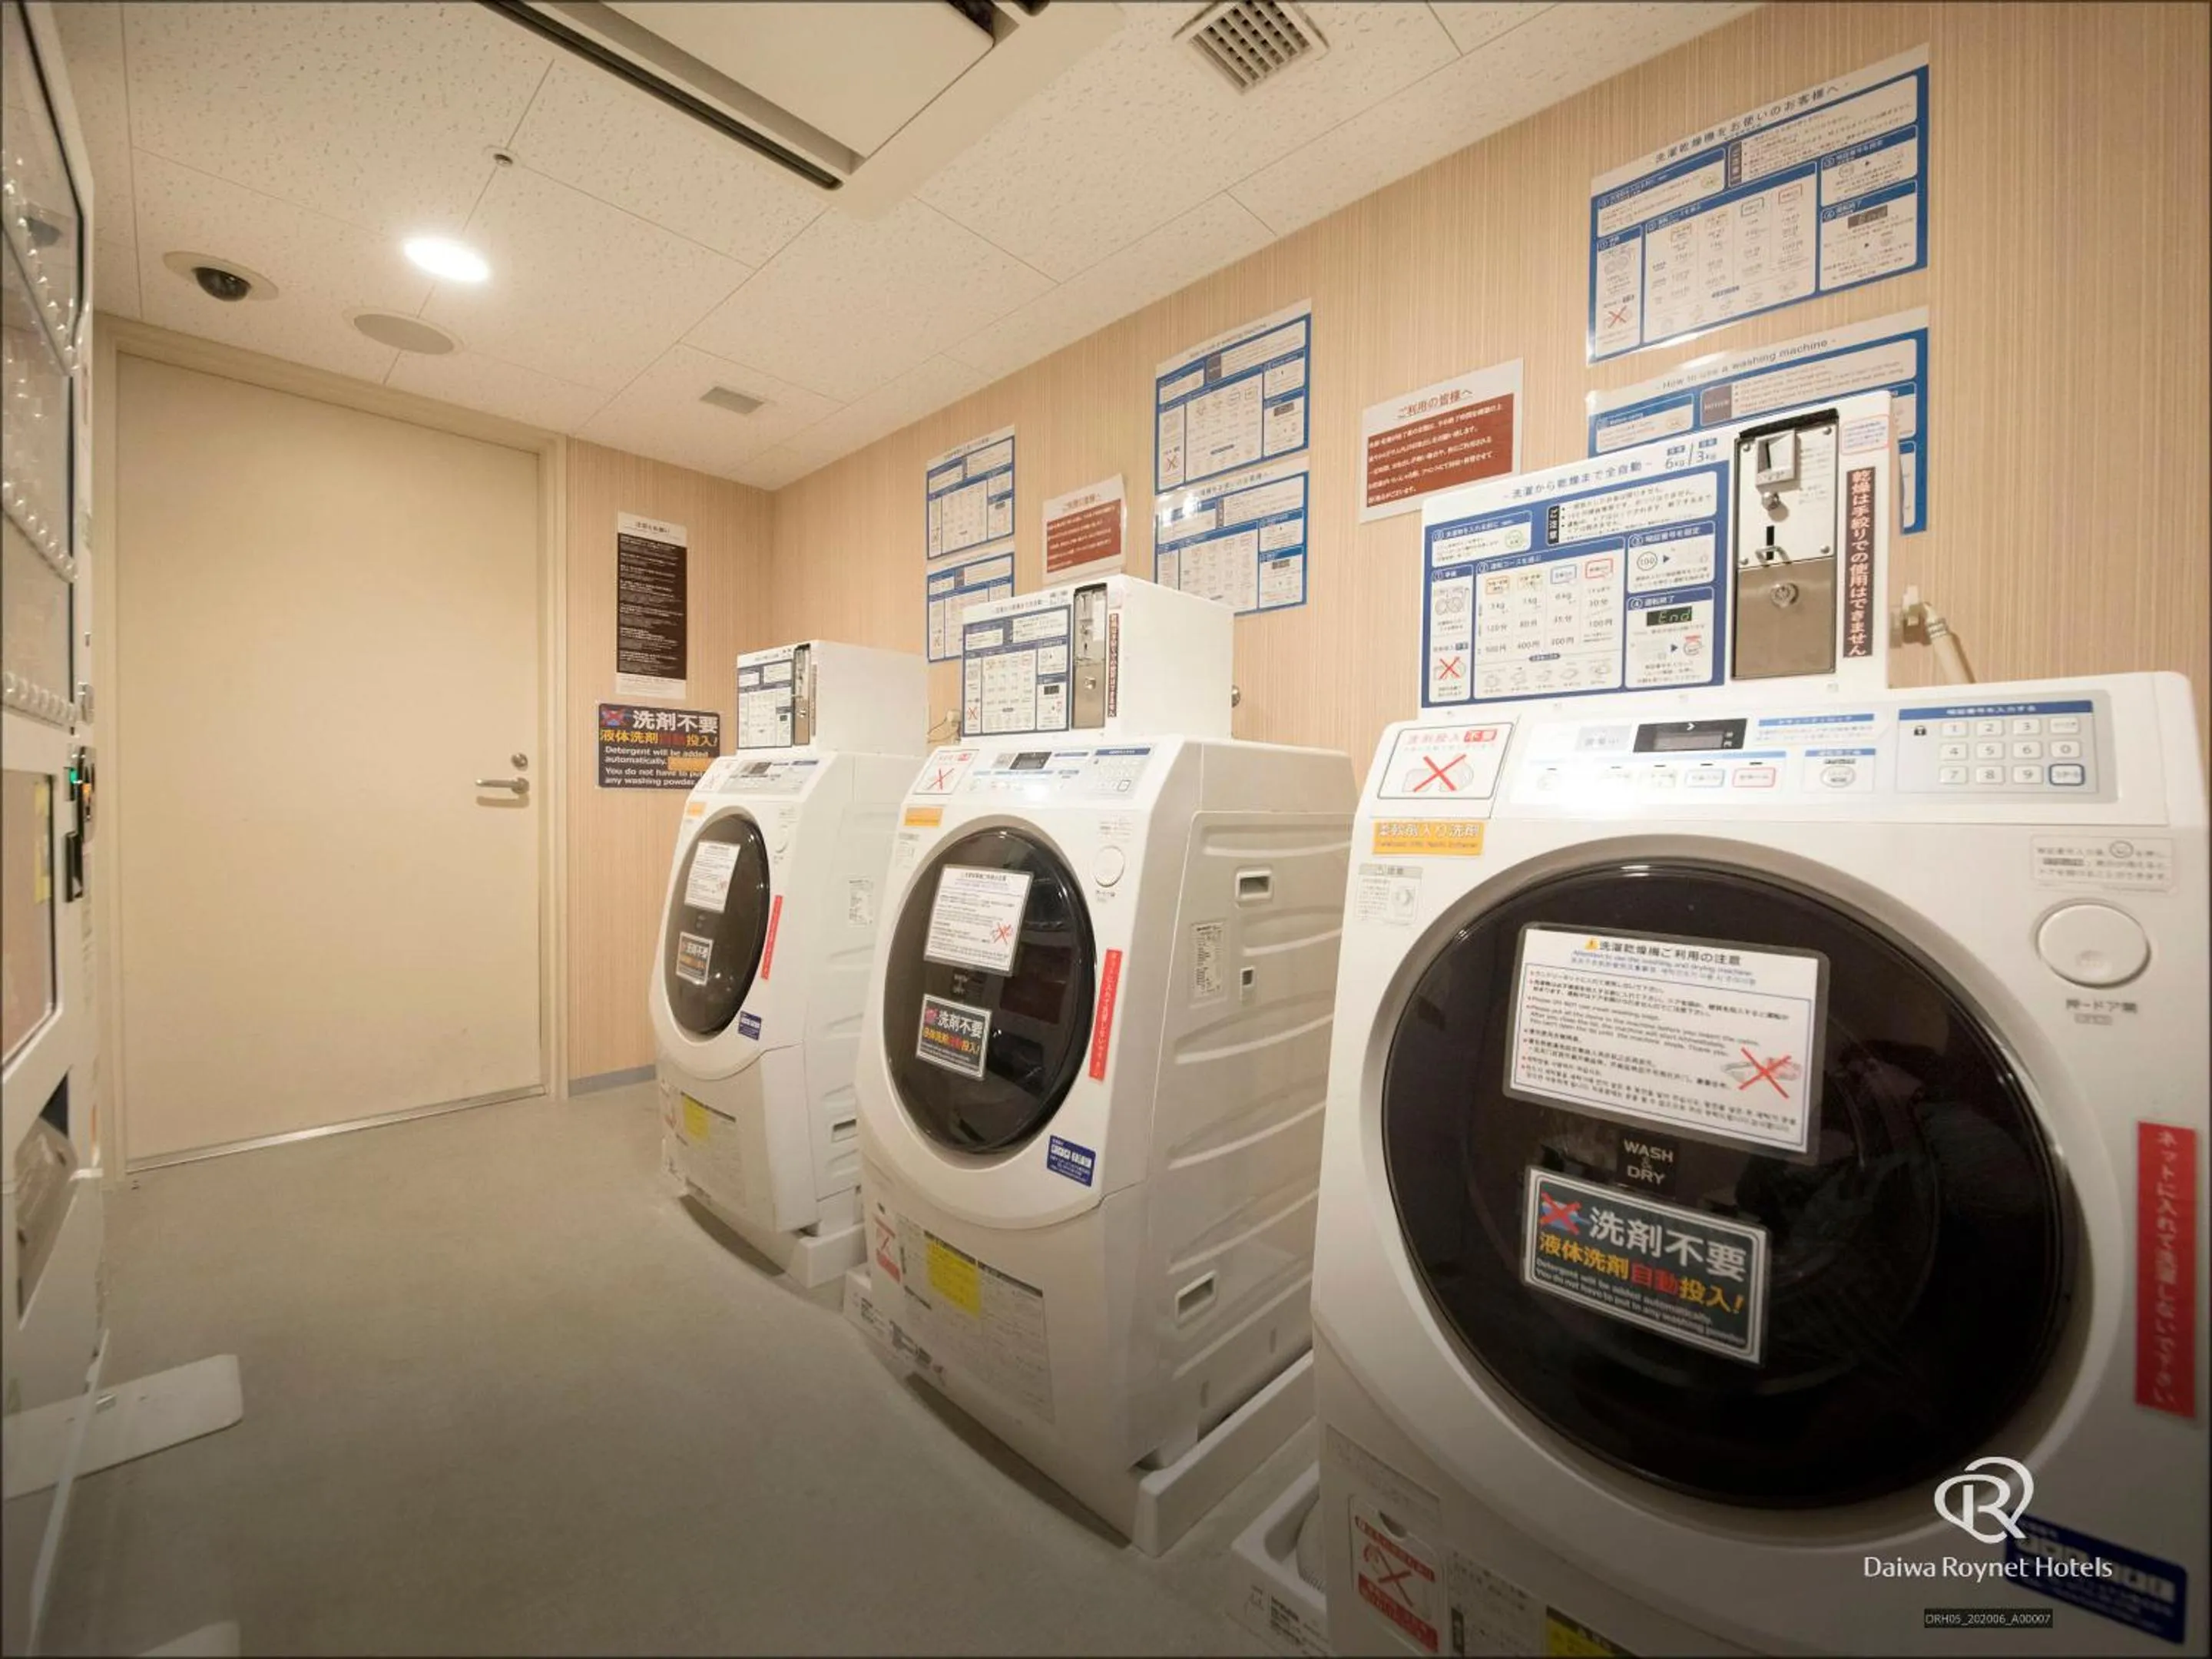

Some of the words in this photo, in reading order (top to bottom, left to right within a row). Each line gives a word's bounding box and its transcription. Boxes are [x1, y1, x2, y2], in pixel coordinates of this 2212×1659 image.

[1655, 84, 1839, 164] 洗濯乾燥機をお使いのお客様へ
[1732, 351, 1776, 371] washing
[1779, 338, 1828, 360] machine
[1512, 461, 1642, 498] 洗濯から乾燥まで全自動
[1847, 469, 1871, 657] 乾燥は手絞りでの使用はできません
[633, 710, 718, 734] 洗剤不要
[605, 746, 651, 757] Detergent
[605, 776, 623, 785] any
[624, 777, 661, 786] washing
[1599, 942, 1741, 966] 洗濯乾燥機ご利用の注意
[938, 1009, 983, 1039] 洗剤不要
[1624, 1139, 1674, 1163] WASH
[1627, 1166, 1666, 1184] DRY
[1590, 1207, 1747, 1282] 洗剤不要
[1539, 1231, 1745, 1313] 液体洗剤自動投入!
